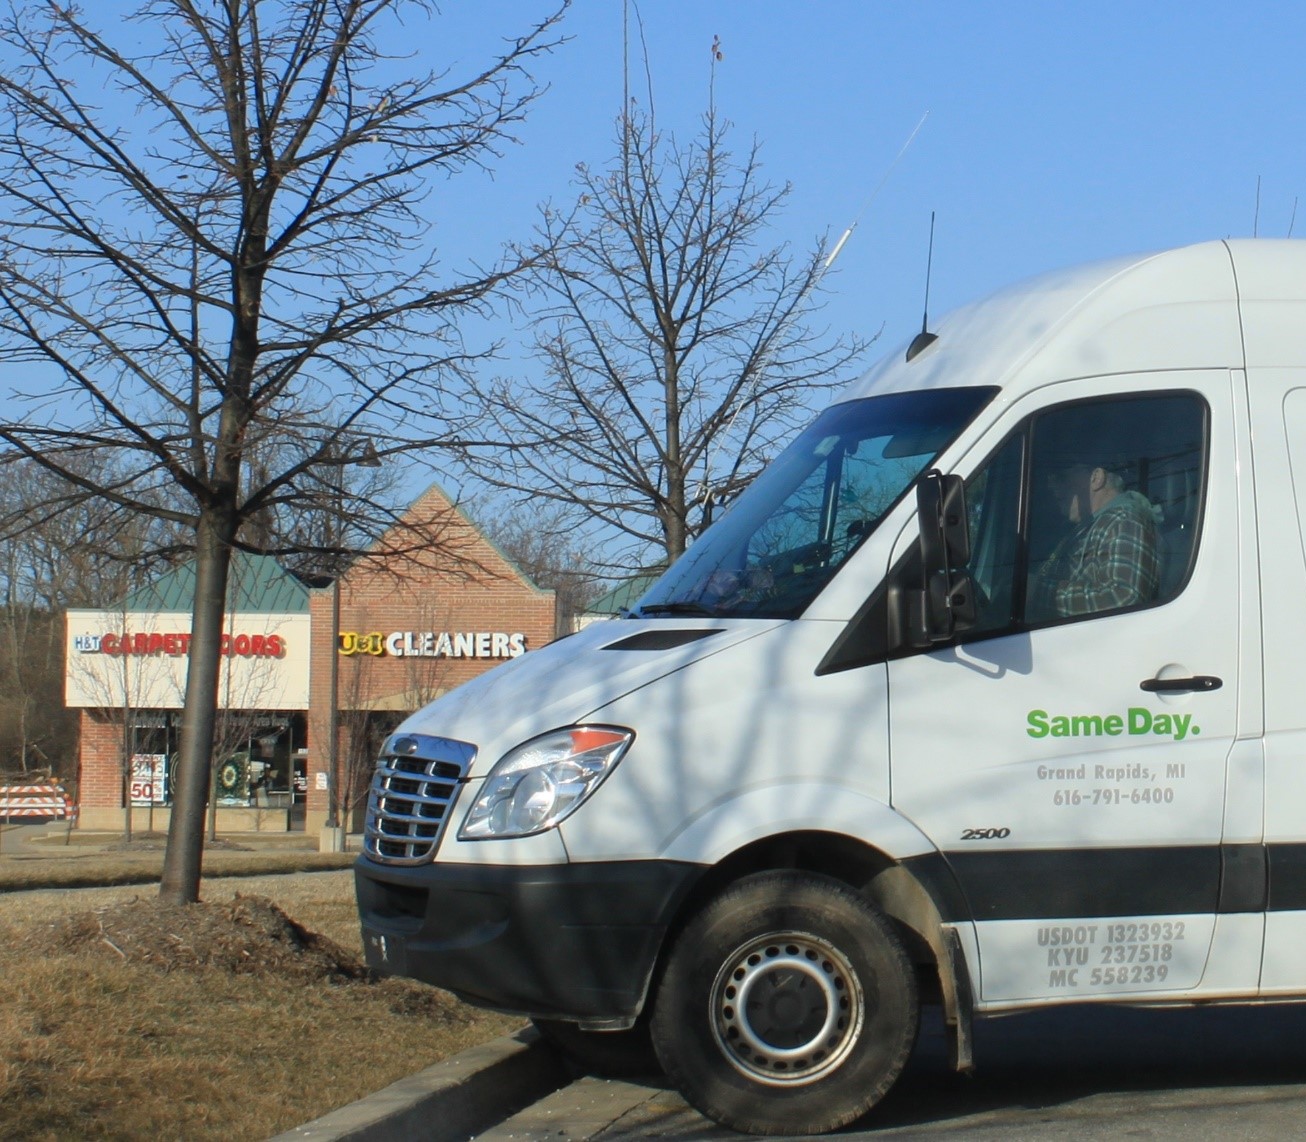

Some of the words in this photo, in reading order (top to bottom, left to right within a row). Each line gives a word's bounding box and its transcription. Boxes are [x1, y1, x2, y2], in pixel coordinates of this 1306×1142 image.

[75, 636, 99, 650] H&T
[101, 633, 192, 655] CARPET
[386, 632, 526, 658] CLEANERS
[1027, 709, 1124, 739] Same
[1128, 707, 1201, 740] Day.
[1037, 764, 1085, 780] Grand
[1094, 764, 1156, 782] Rapids,
[1166, 764, 1186, 779] MI
[1053, 787, 1174, 806] 616-791-6400
[960, 827, 1011, 841] 2500
[1037, 926, 1098, 946] USDOT
[1107, 921, 1186, 943] 1323932
[1047, 947, 1089, 967] KYU
[1101, 944, 1173, 964] 237518
[1049, 968, 1079, 988] MC
[1089, 965, 1169, 986] 558239
